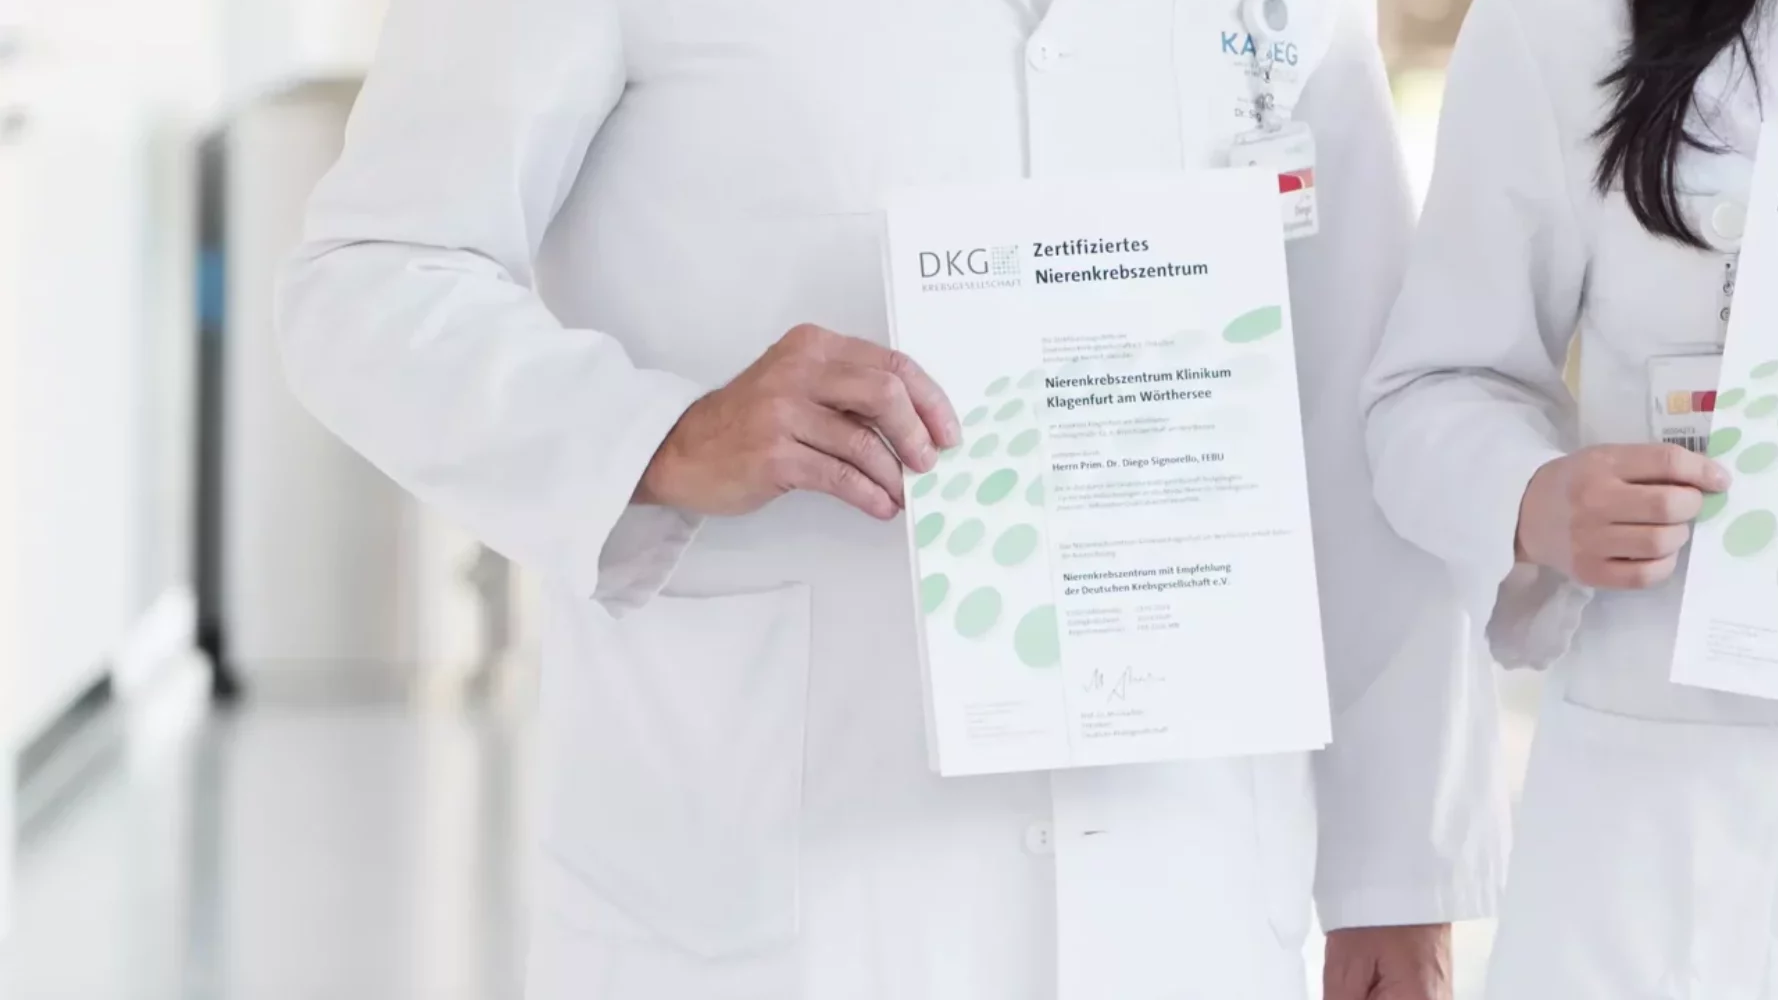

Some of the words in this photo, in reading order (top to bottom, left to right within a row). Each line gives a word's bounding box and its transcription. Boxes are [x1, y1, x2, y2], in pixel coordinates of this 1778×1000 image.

[1221, 31, 1298, 66] KAEG
[1033, 238, 1149, 257] Zertifiziertes
[919, 248, 988, 278] DKG
[1036, 263, 1208, 284] Nierenkrebszentrum
[1045, 371, 1173, 388] Nierenkrebszentrum
[1176, 367, 1232, 380] Klinikum
[1047, 393, 1114, 410] Klagenfurt
[1118, 394, 1137, 403] am
[1140, 388, 1212, 402] Wörthersee
[1052, 463, 1079, 471] Herrn
[1122, 458, 1150, 468] Diego
[1063, 568, 1157, 581] Nierenkrebszentrum
[1159, 566, 1175, 575] mit
[1176, 563, 1232, 575] Empfehlung
[1065, 586, 1080, 595] der
[1082, 583, 1130, 595] Deutschen
[1132, 577, 1211, 592] Krebsgesellschaft
